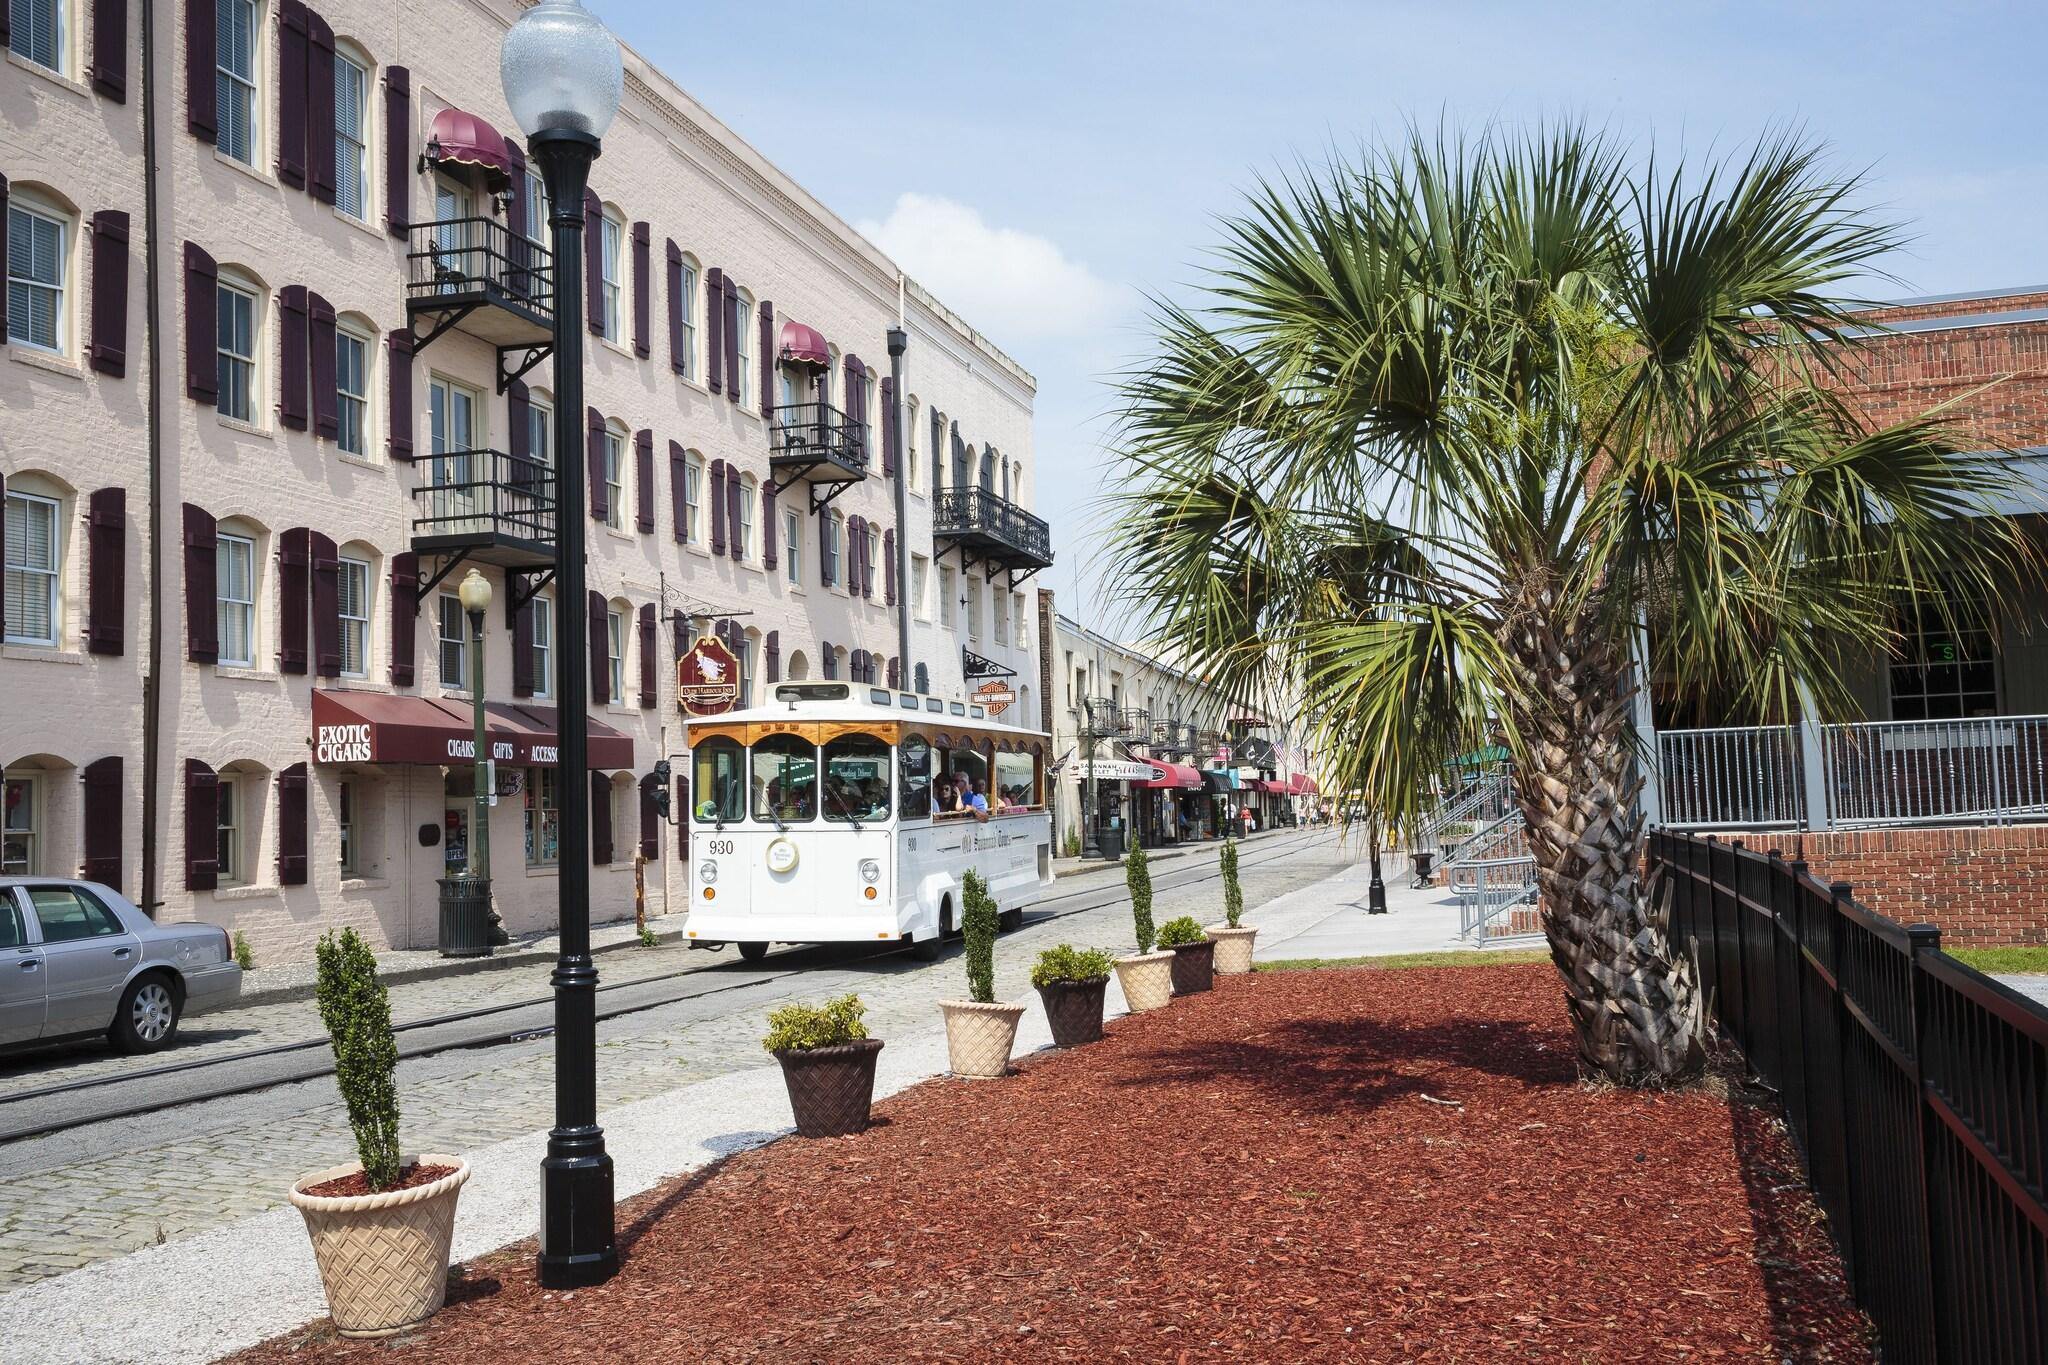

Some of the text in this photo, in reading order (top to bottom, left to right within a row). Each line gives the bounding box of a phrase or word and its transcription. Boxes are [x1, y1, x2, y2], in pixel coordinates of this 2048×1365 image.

[722, 686, 733, 694] INN
[318, 724, 371, 744] EXOTIC
[317, 742, 371, 763] CIGARS
[447, 739, 475, 758] CIGARS
[493, 742, 514, 760] GIFTS
[709, 840, 734, 855] 930
